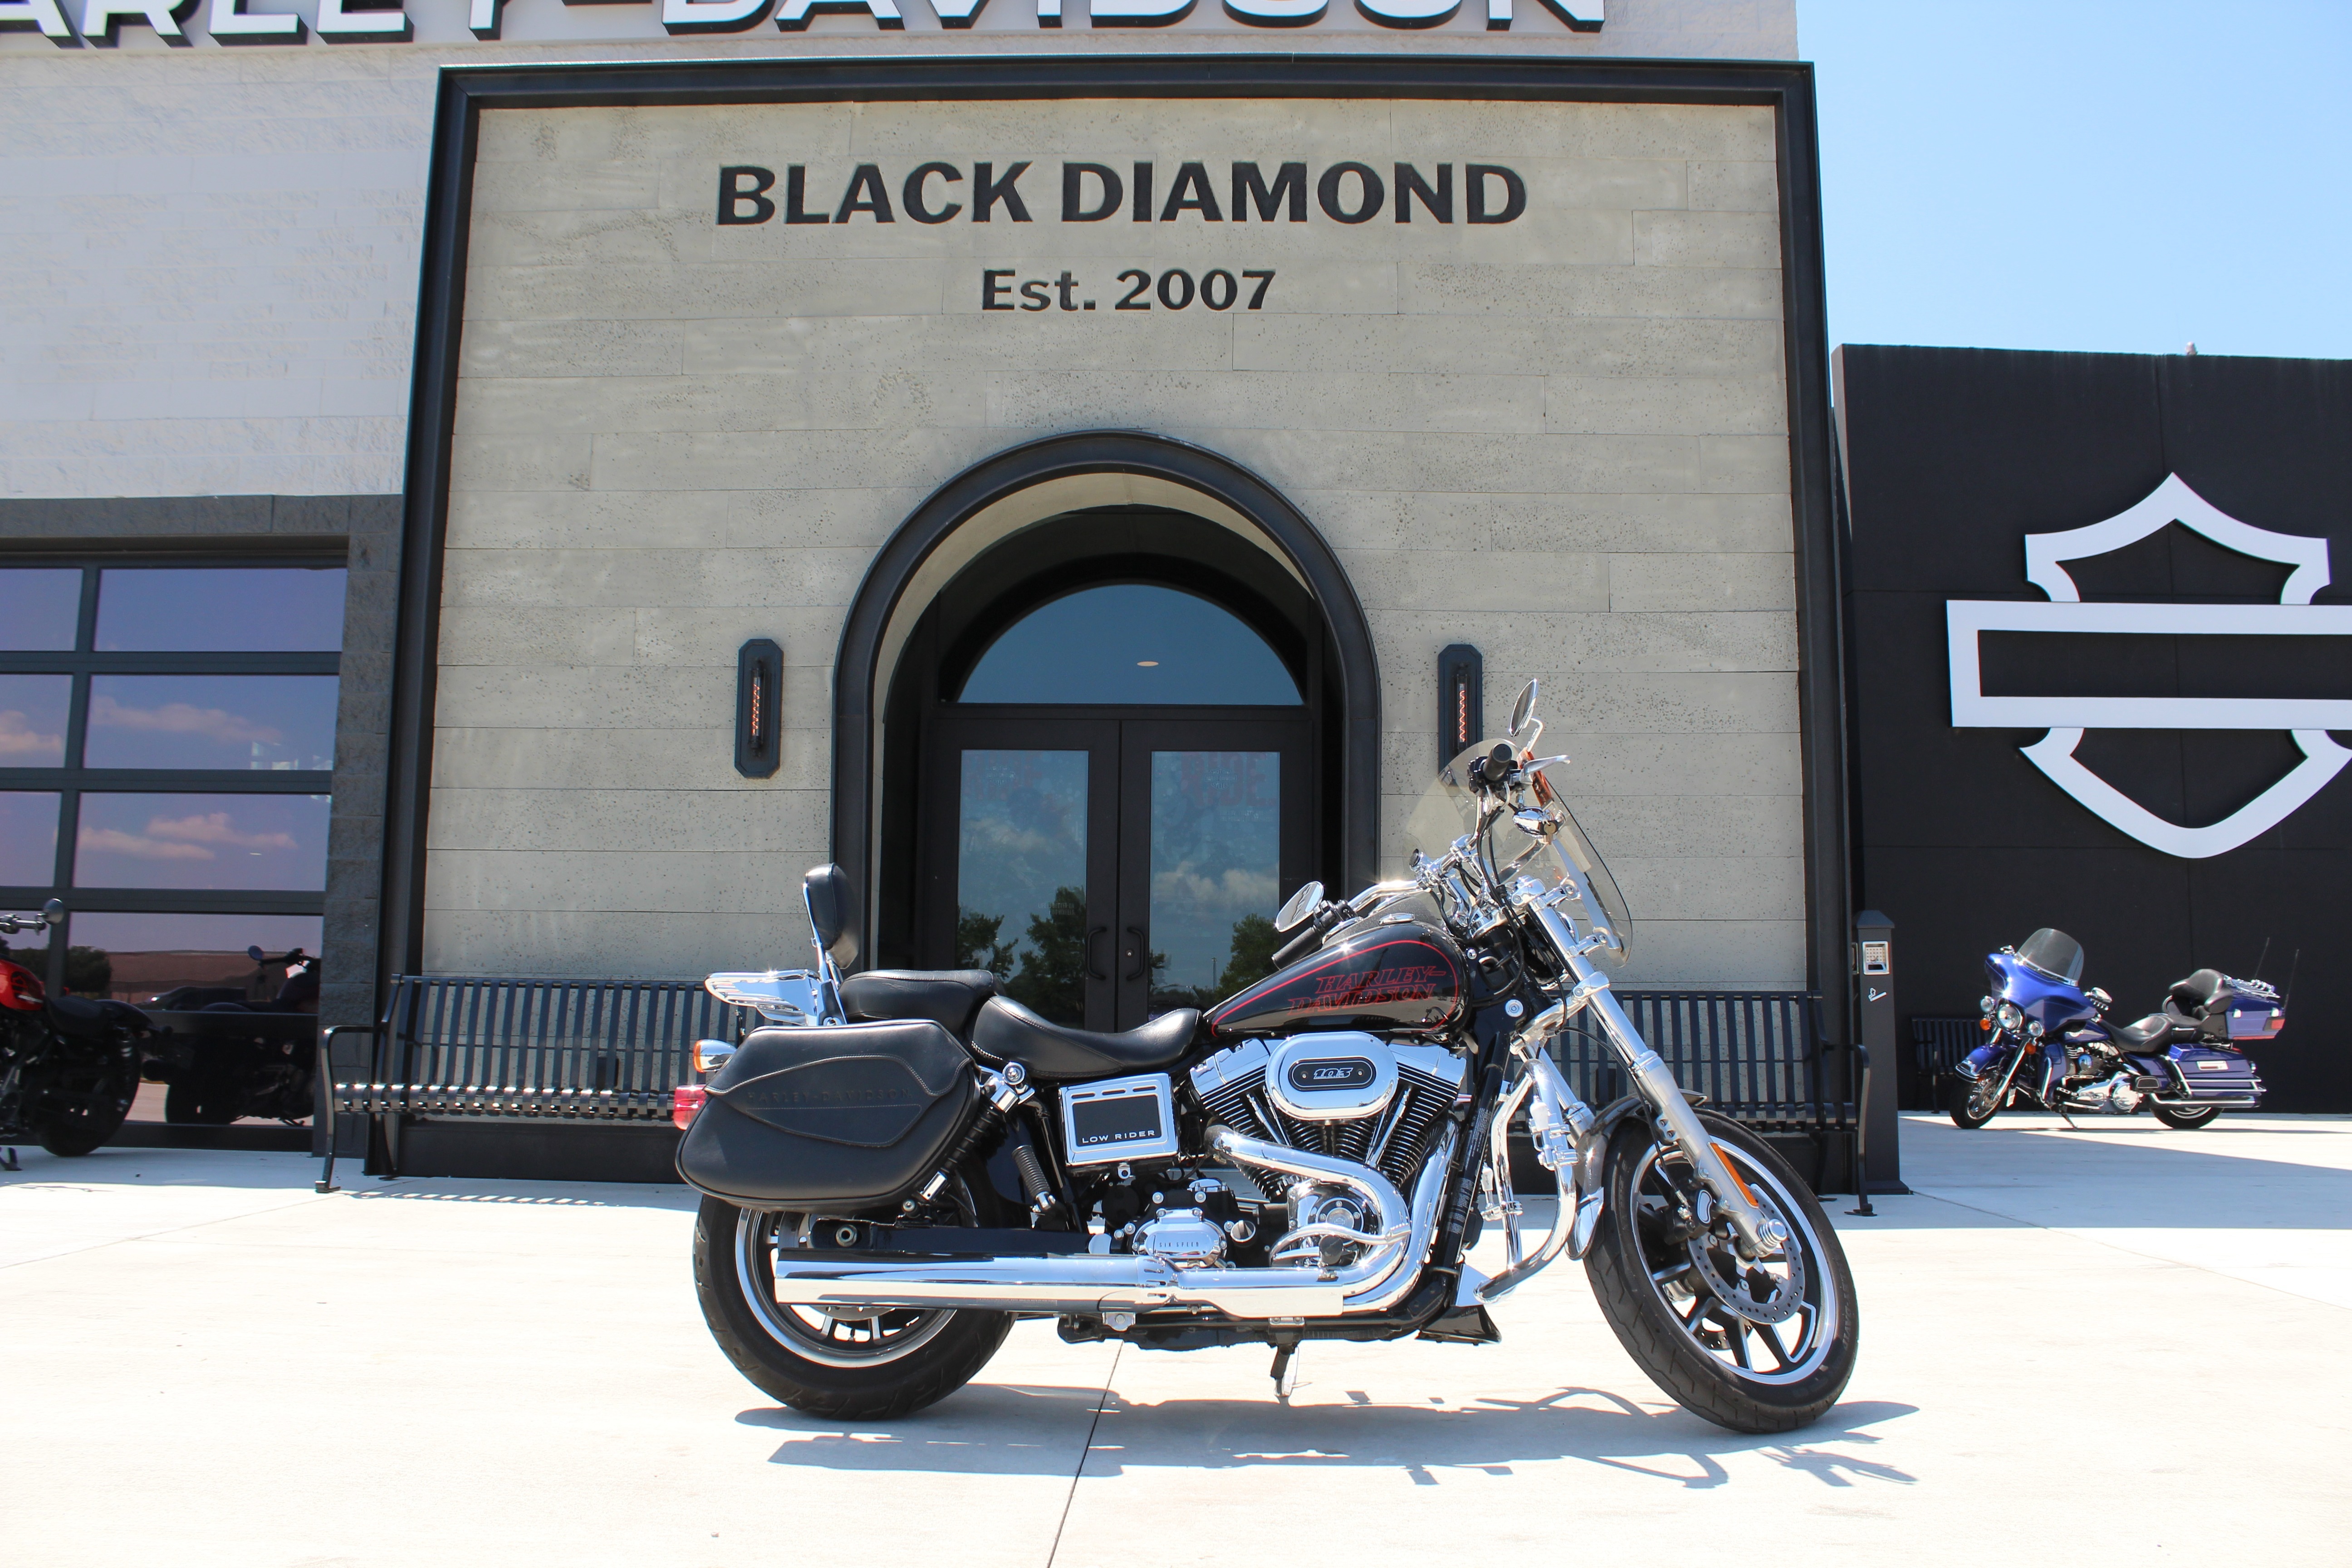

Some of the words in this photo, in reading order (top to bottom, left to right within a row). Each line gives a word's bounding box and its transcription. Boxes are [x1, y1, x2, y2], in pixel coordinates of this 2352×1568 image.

[717, 161, 1034, 225] BLACK
[1061, 161, 1527, 225] DIAMOND
[982, 269, 1096, 312] Est.
[1114, 269, 1276, 311] 2007
[1315, 966, 1446, 994] HARLEY-
[1287, 983, 1437, 1016] DAVIDSON
[1313, 1067, 1354, 1080] 103
[1082, 1135, 1109, 1144] LOW
[1115, 1130, 1155, 1140] RIDER
